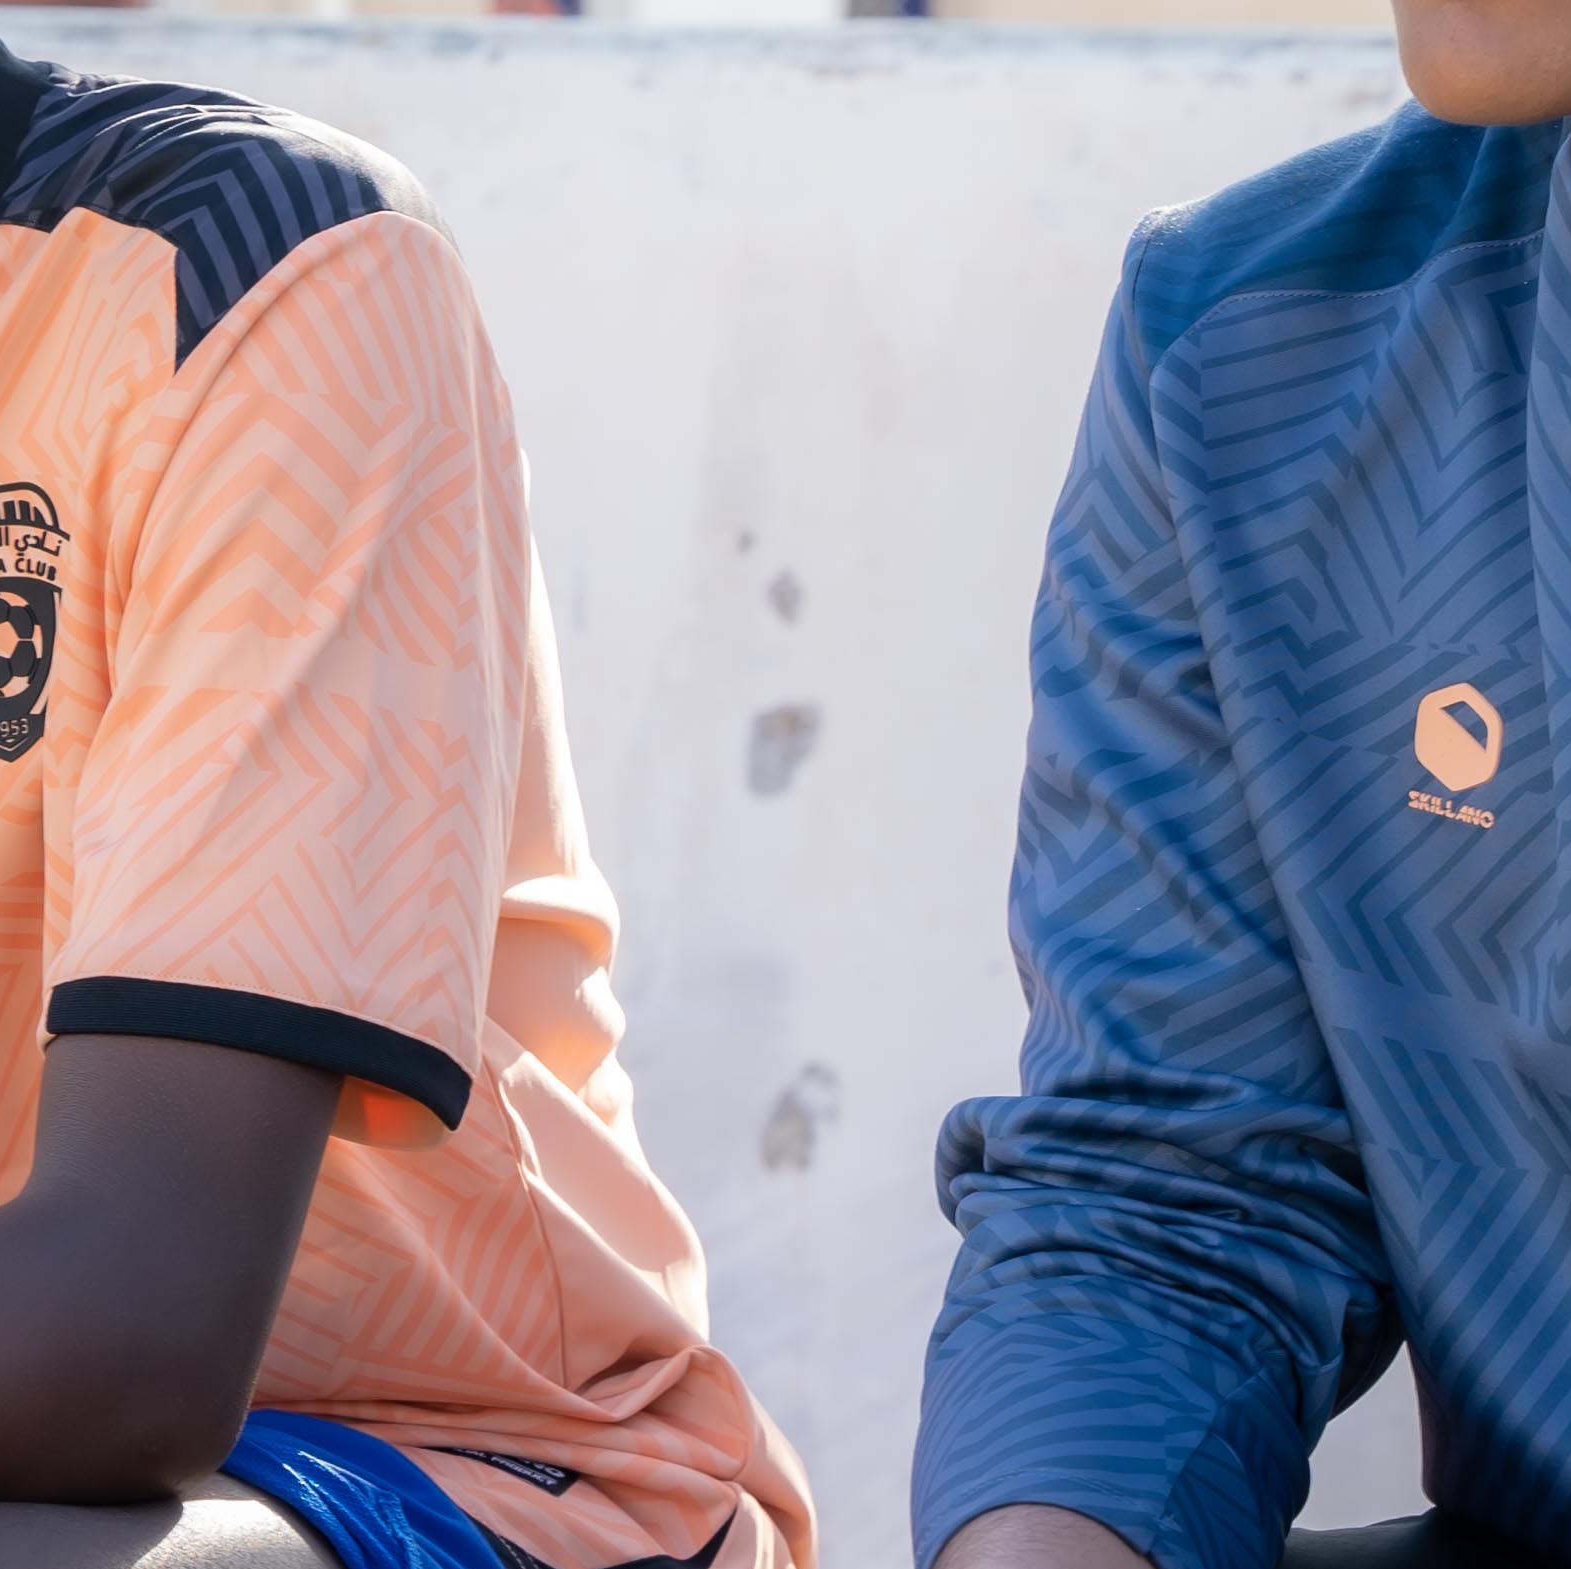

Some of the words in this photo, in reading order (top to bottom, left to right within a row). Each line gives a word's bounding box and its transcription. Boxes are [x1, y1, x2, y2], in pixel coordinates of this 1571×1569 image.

[14, 530, 63, 557] نادي
[15, 558, 57, 582] CLUB
[1407, 789, 1496, 830] SKILLANO
